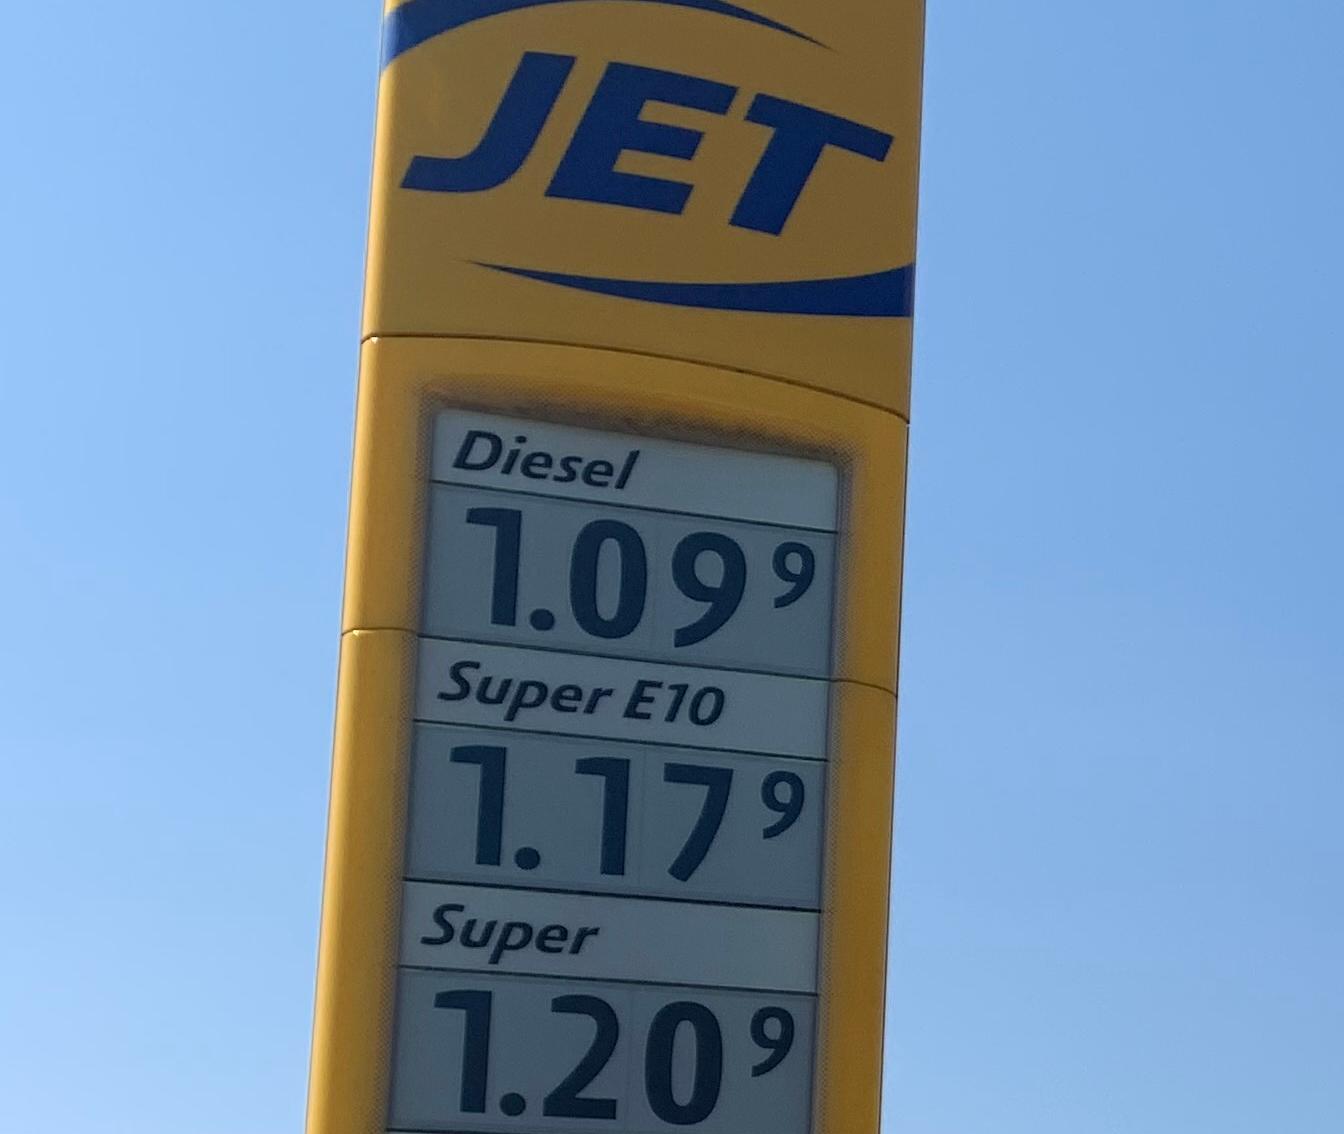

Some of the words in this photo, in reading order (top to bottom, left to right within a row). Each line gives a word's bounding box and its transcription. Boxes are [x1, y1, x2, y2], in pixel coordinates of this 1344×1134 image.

[401, 51, 894, 236] JET
[453, 430, 640, 489] Diesel
[437, 661, 613, 721] Super
[622, 679, 725, 727] E10
[420, 904, 600, 965] Super
